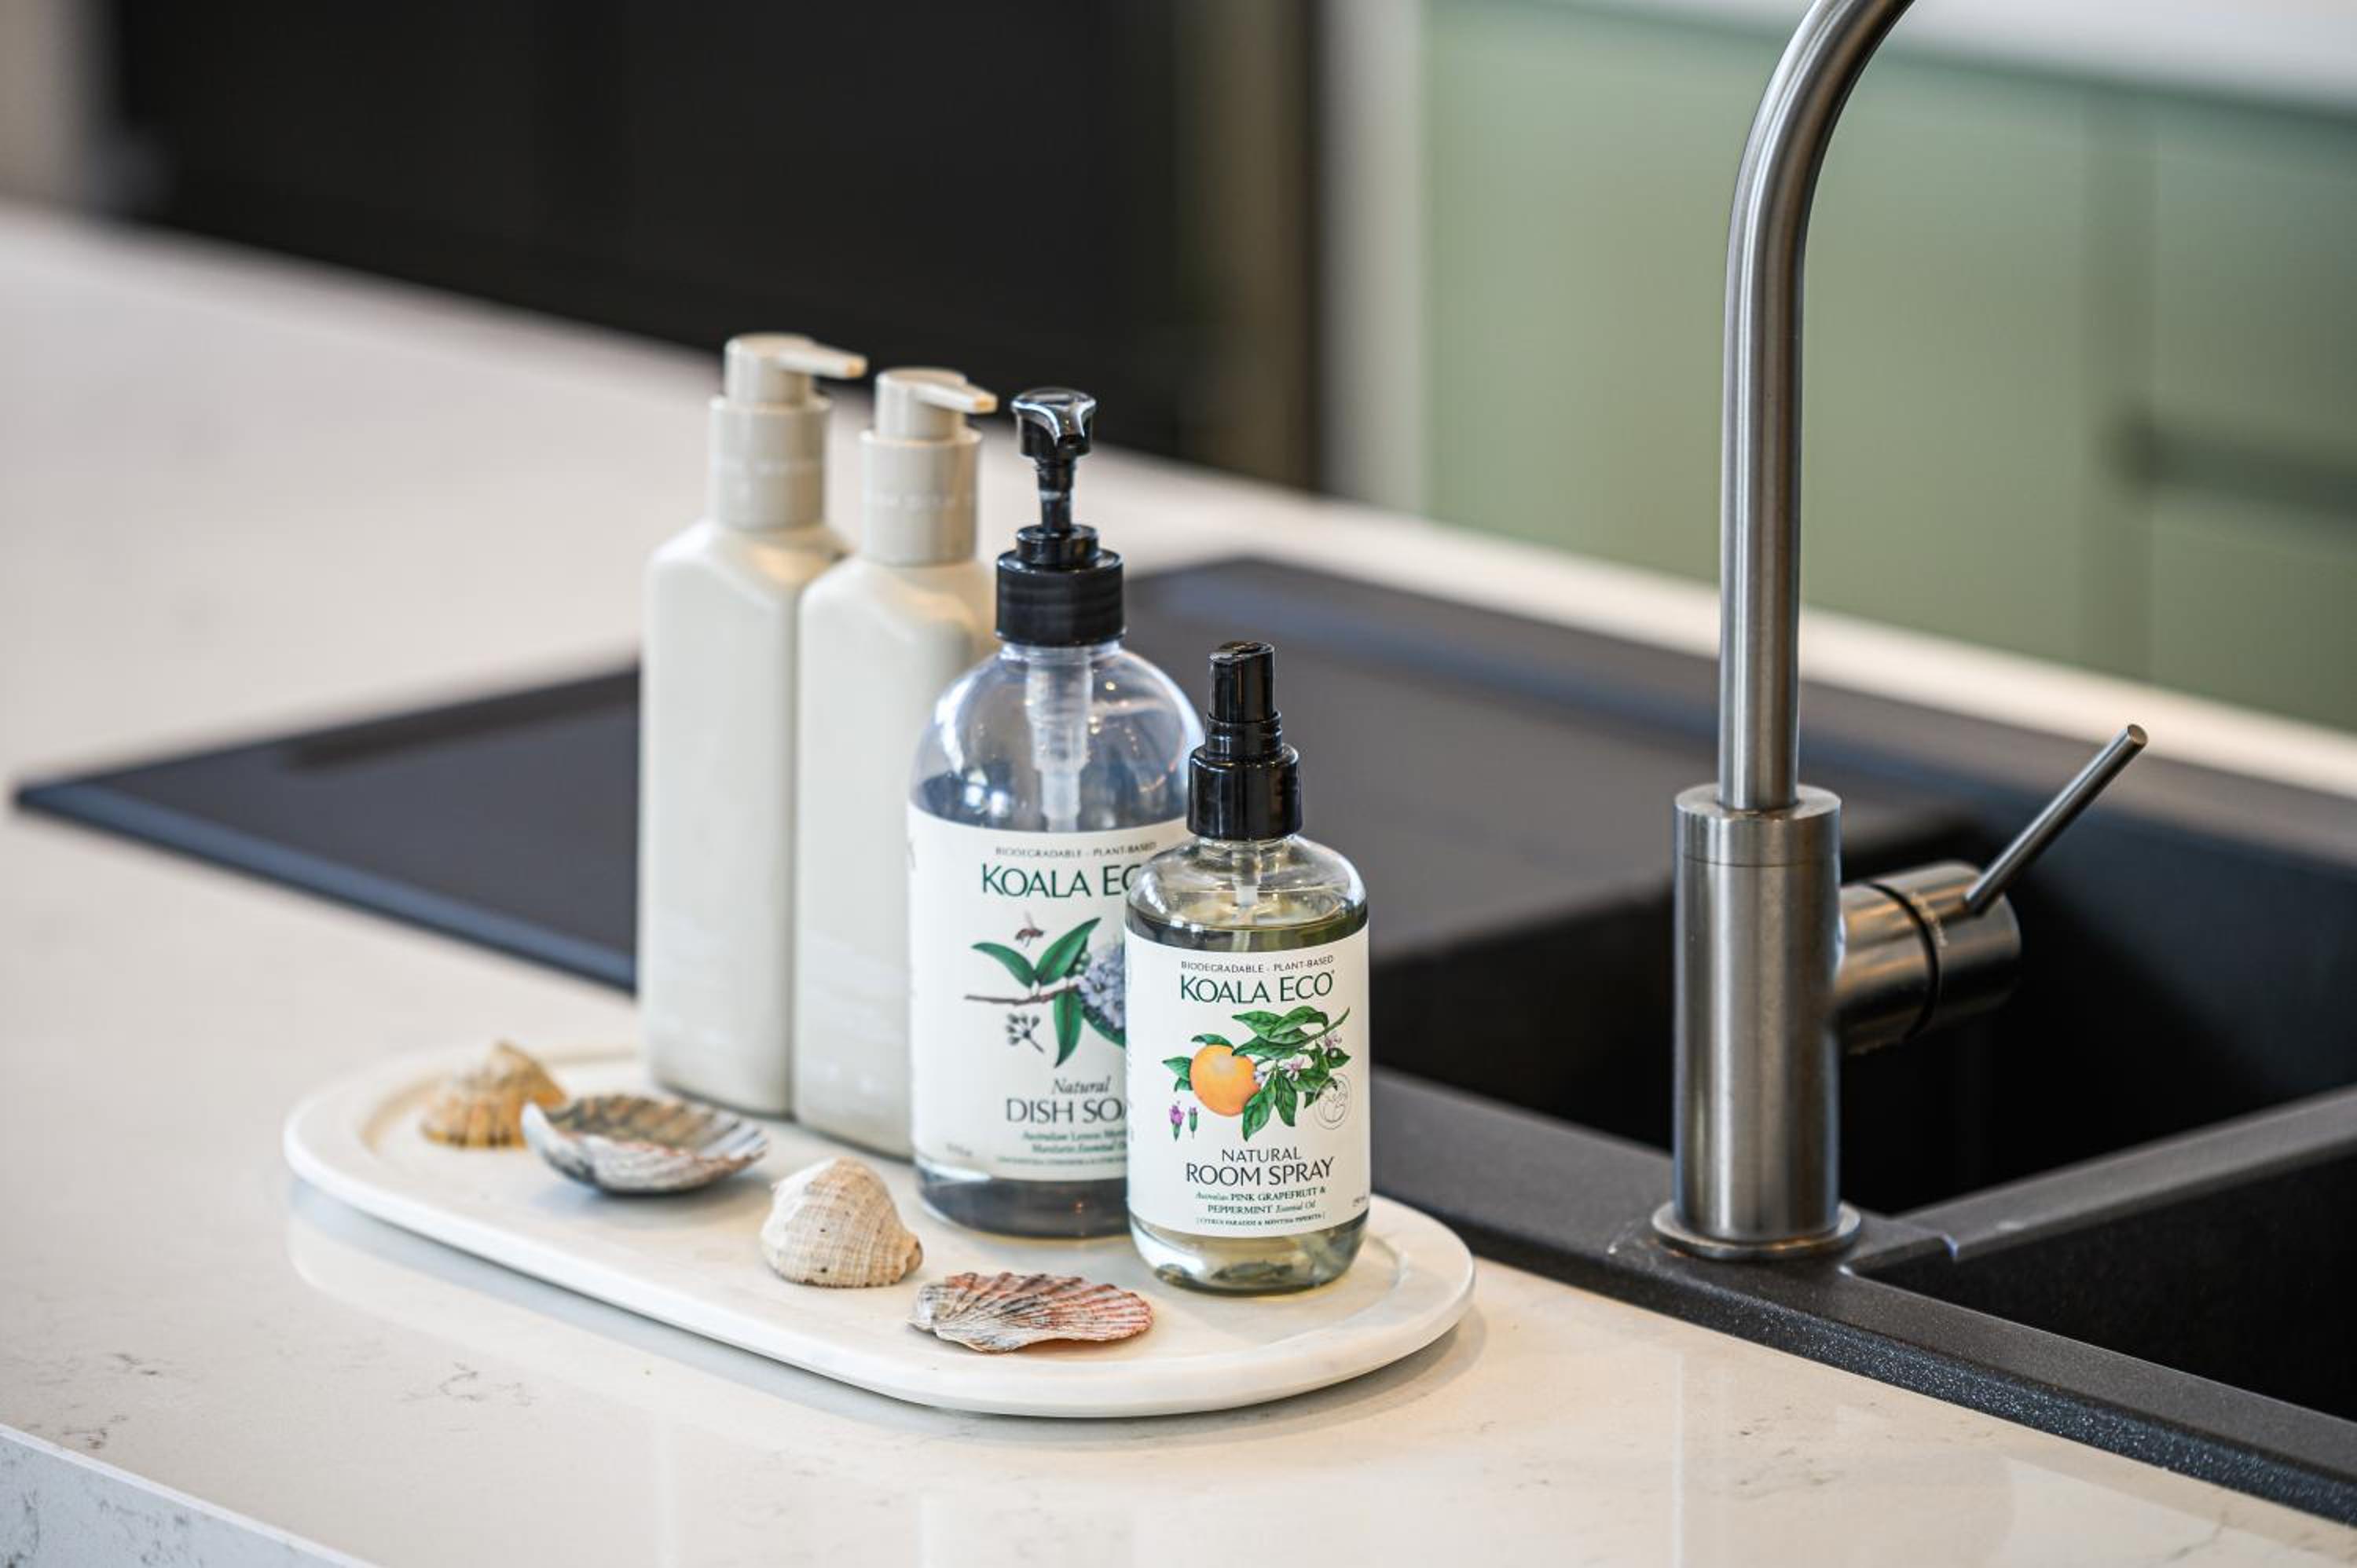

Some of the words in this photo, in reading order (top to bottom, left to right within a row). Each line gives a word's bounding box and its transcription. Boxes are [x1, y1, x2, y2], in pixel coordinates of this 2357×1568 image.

[995, 846, 1081, 858] BIODEGRADABLE
[1094, 841, 1157, 856] PLANT-BASED
[982, 863, 1092, 898] KOALA
[1103, 865, 1142, 896] EC
[1181, 960, 1264, 973] BIODEGRADABLE
[1274, 954, 1334, 972] PLANT-BASED
[1180, 974, 1271, 1004] KOALA
[1052, 1075, 1112, 1094] Natural
[1006, 1097, 1074, 1124] DISH
[1083, 1097, 1127, 1124] SO
[1221, 1145, 1303, 1163] NATURAL
[1186, 1162, 1261, 1187] ROOM
[1268, 1156, 1336, 1186] SPRAY
[1230, 1192, 1255, 1202] PINK
[1257, 1186, 1318, 1201] GRAPEFRUIT
[1207, 1203, 1274, 1214] PEPPERMINT
